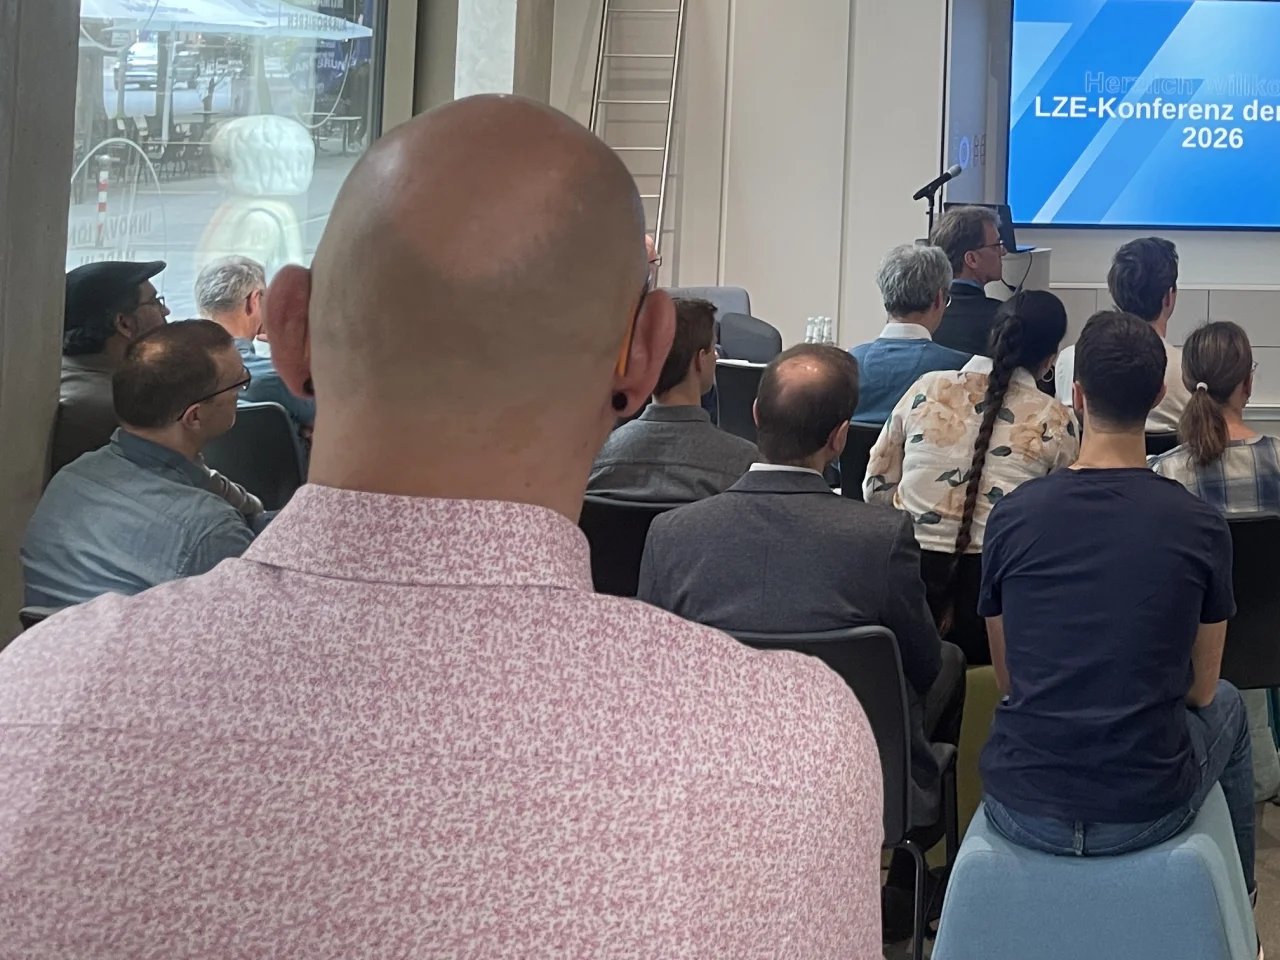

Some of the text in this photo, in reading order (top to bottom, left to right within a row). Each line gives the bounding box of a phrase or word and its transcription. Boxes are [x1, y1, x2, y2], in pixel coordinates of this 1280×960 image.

[1085, 71, 1193, 95] Herzlich
[1035, 96, 1234, 121] LZE-Konferenz
[1181, 127, 1244, 149] 2026
